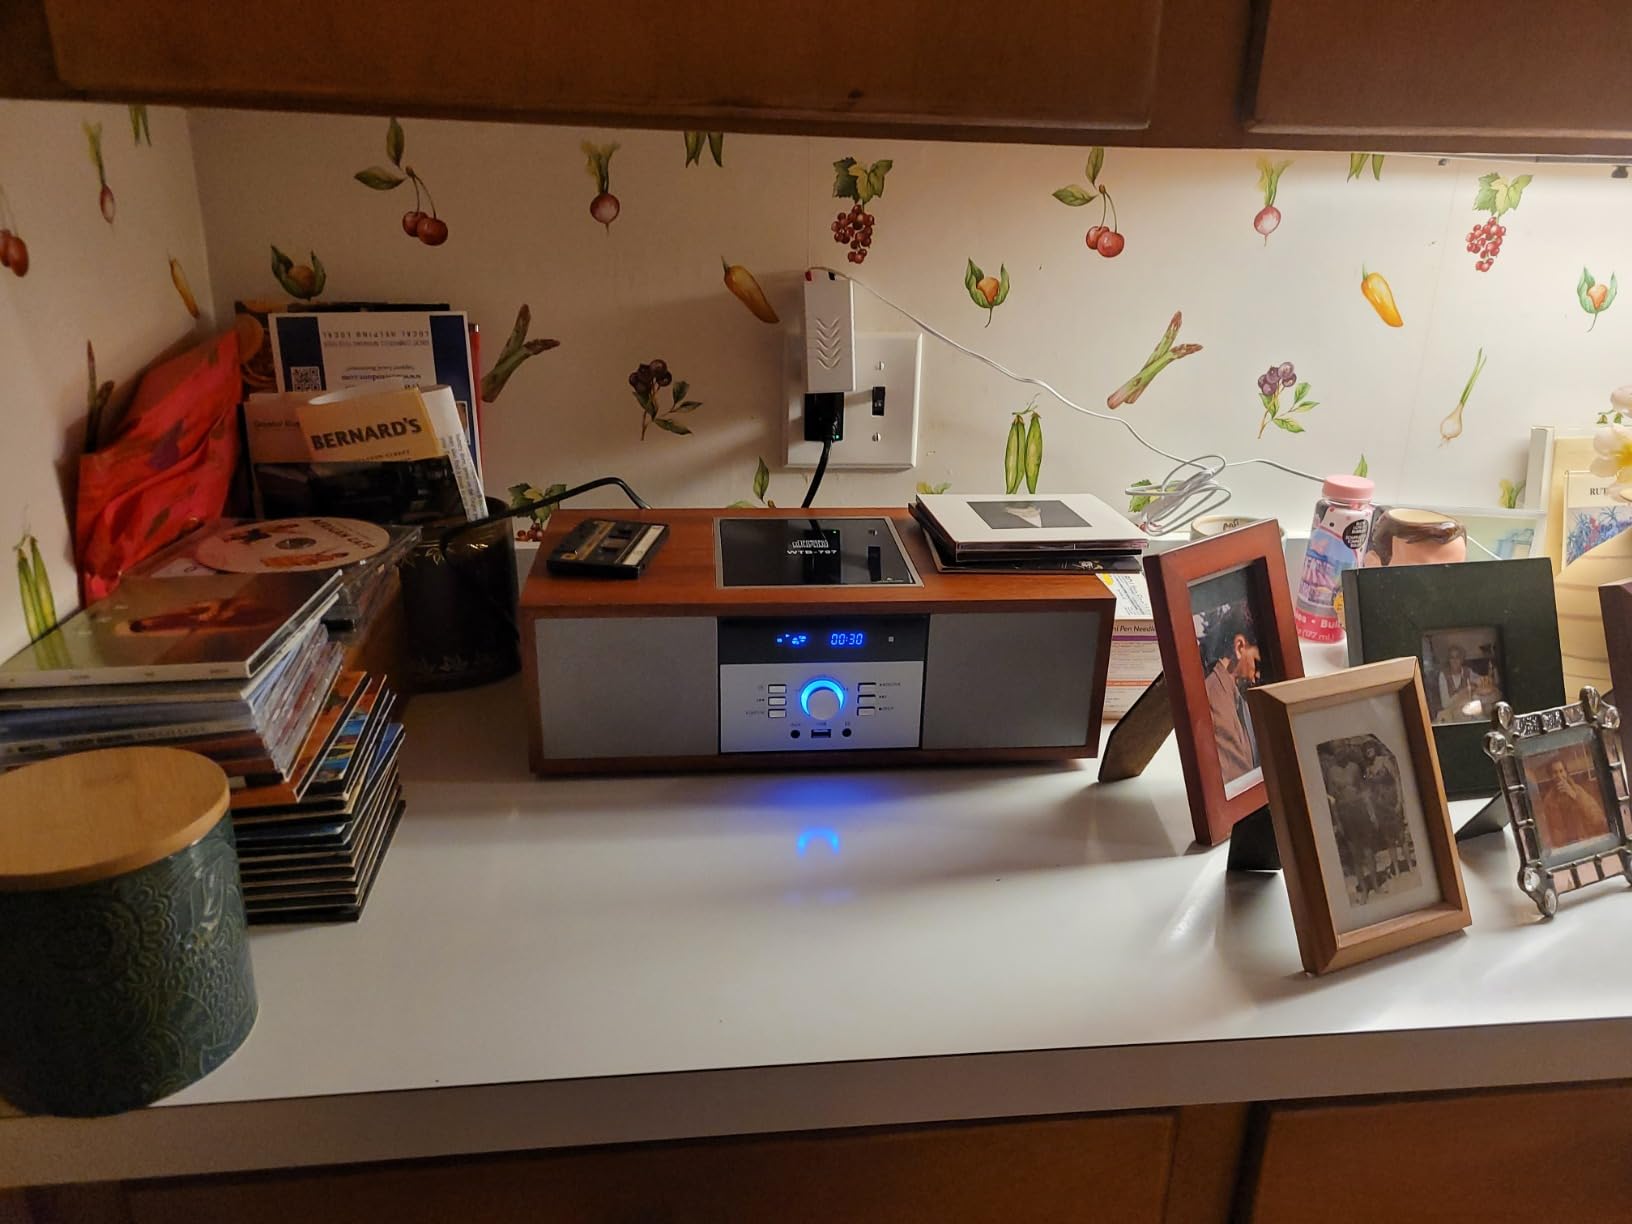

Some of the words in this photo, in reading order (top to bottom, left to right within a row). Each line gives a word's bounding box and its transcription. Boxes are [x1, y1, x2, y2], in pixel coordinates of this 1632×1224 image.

[322, 331, 351, 339] LOCAL
[401, 330, 429, 338] LOCAL
[310, 417, 422, 450] BERNARD'S
[1119, 624, 1131, 632] Pen
[830, 632, 863, 646] 00:30
